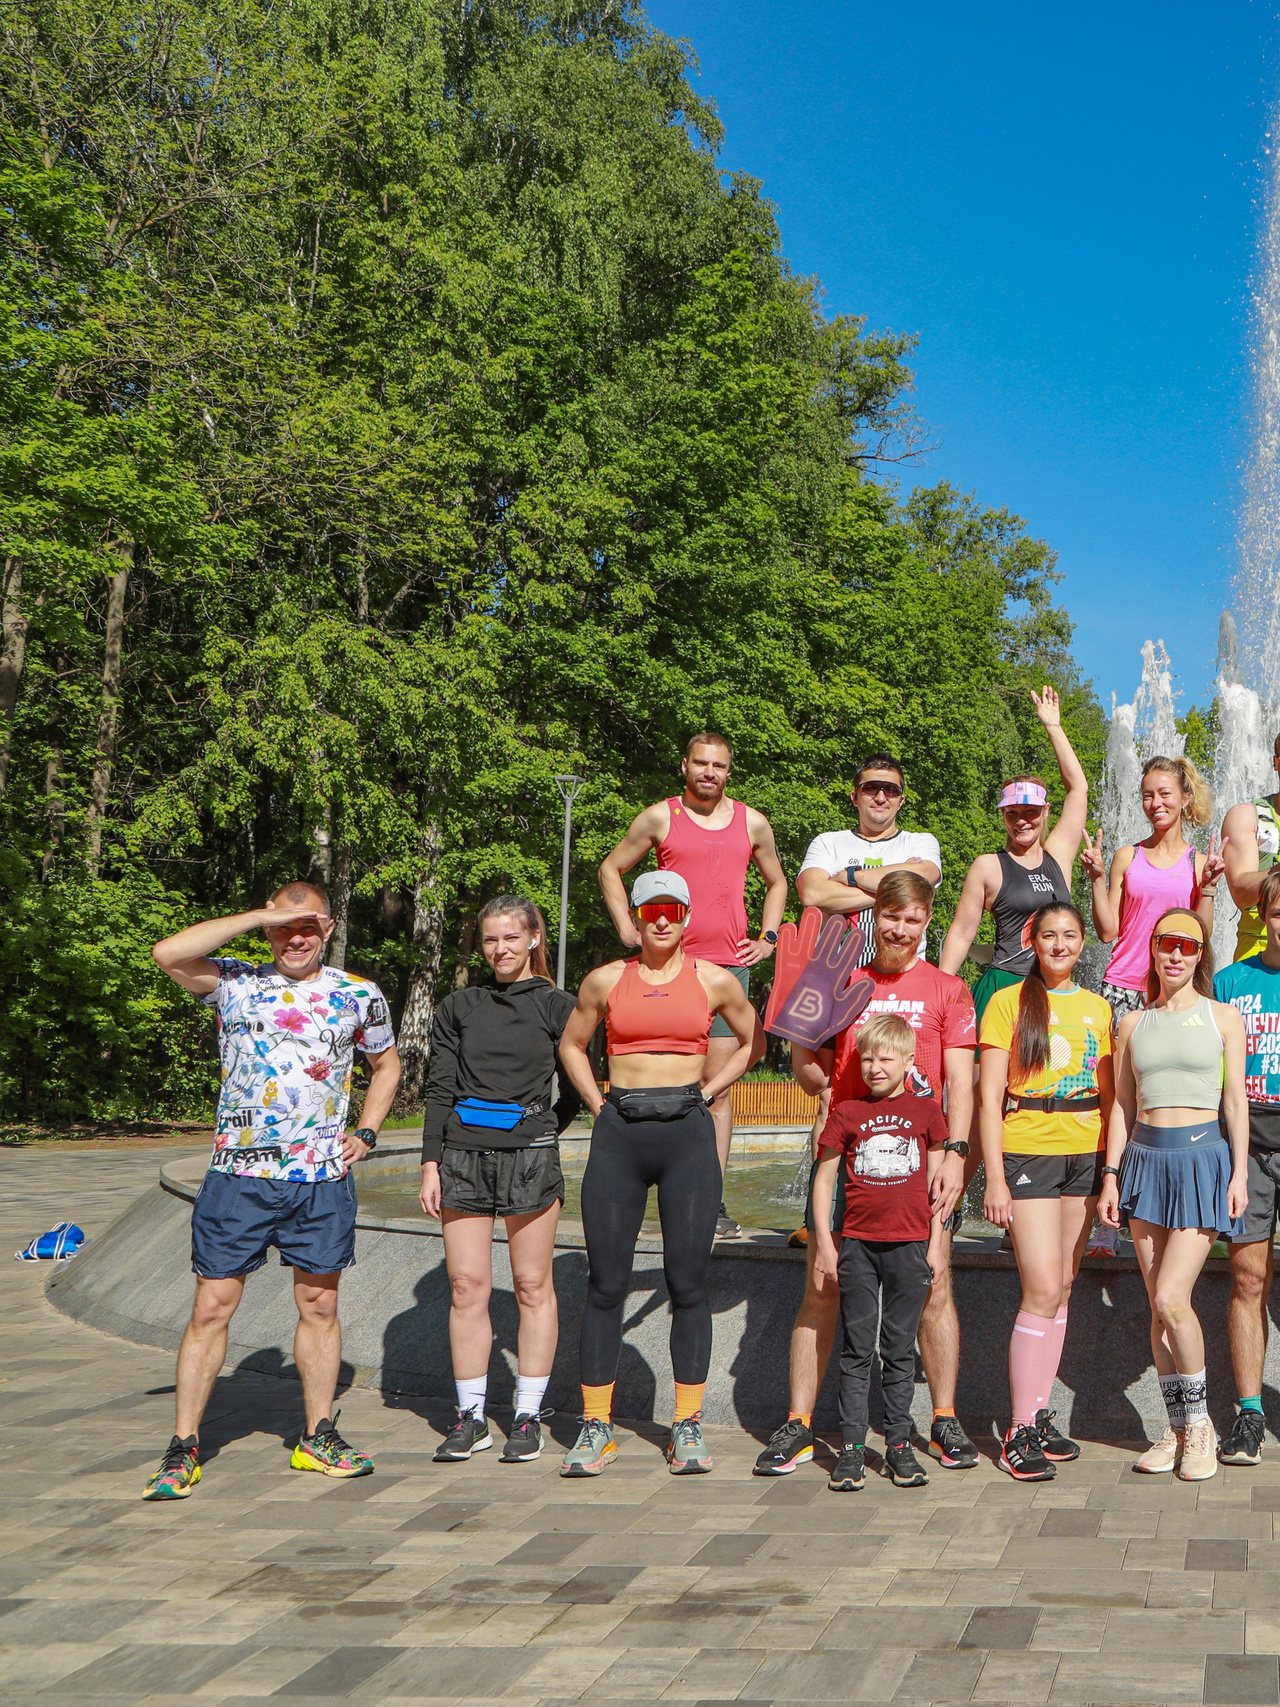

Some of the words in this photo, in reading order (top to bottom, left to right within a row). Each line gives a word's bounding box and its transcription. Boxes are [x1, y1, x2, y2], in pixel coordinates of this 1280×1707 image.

[1028, 873, 1052, 883] ERA.
[1032, 882, 1055, 892] RUN
[865, 1000, 925, 1014] NMAN
[218, 1110, 252, 1128] trail
[860, 1115, 912, 1132] PACIFIC
